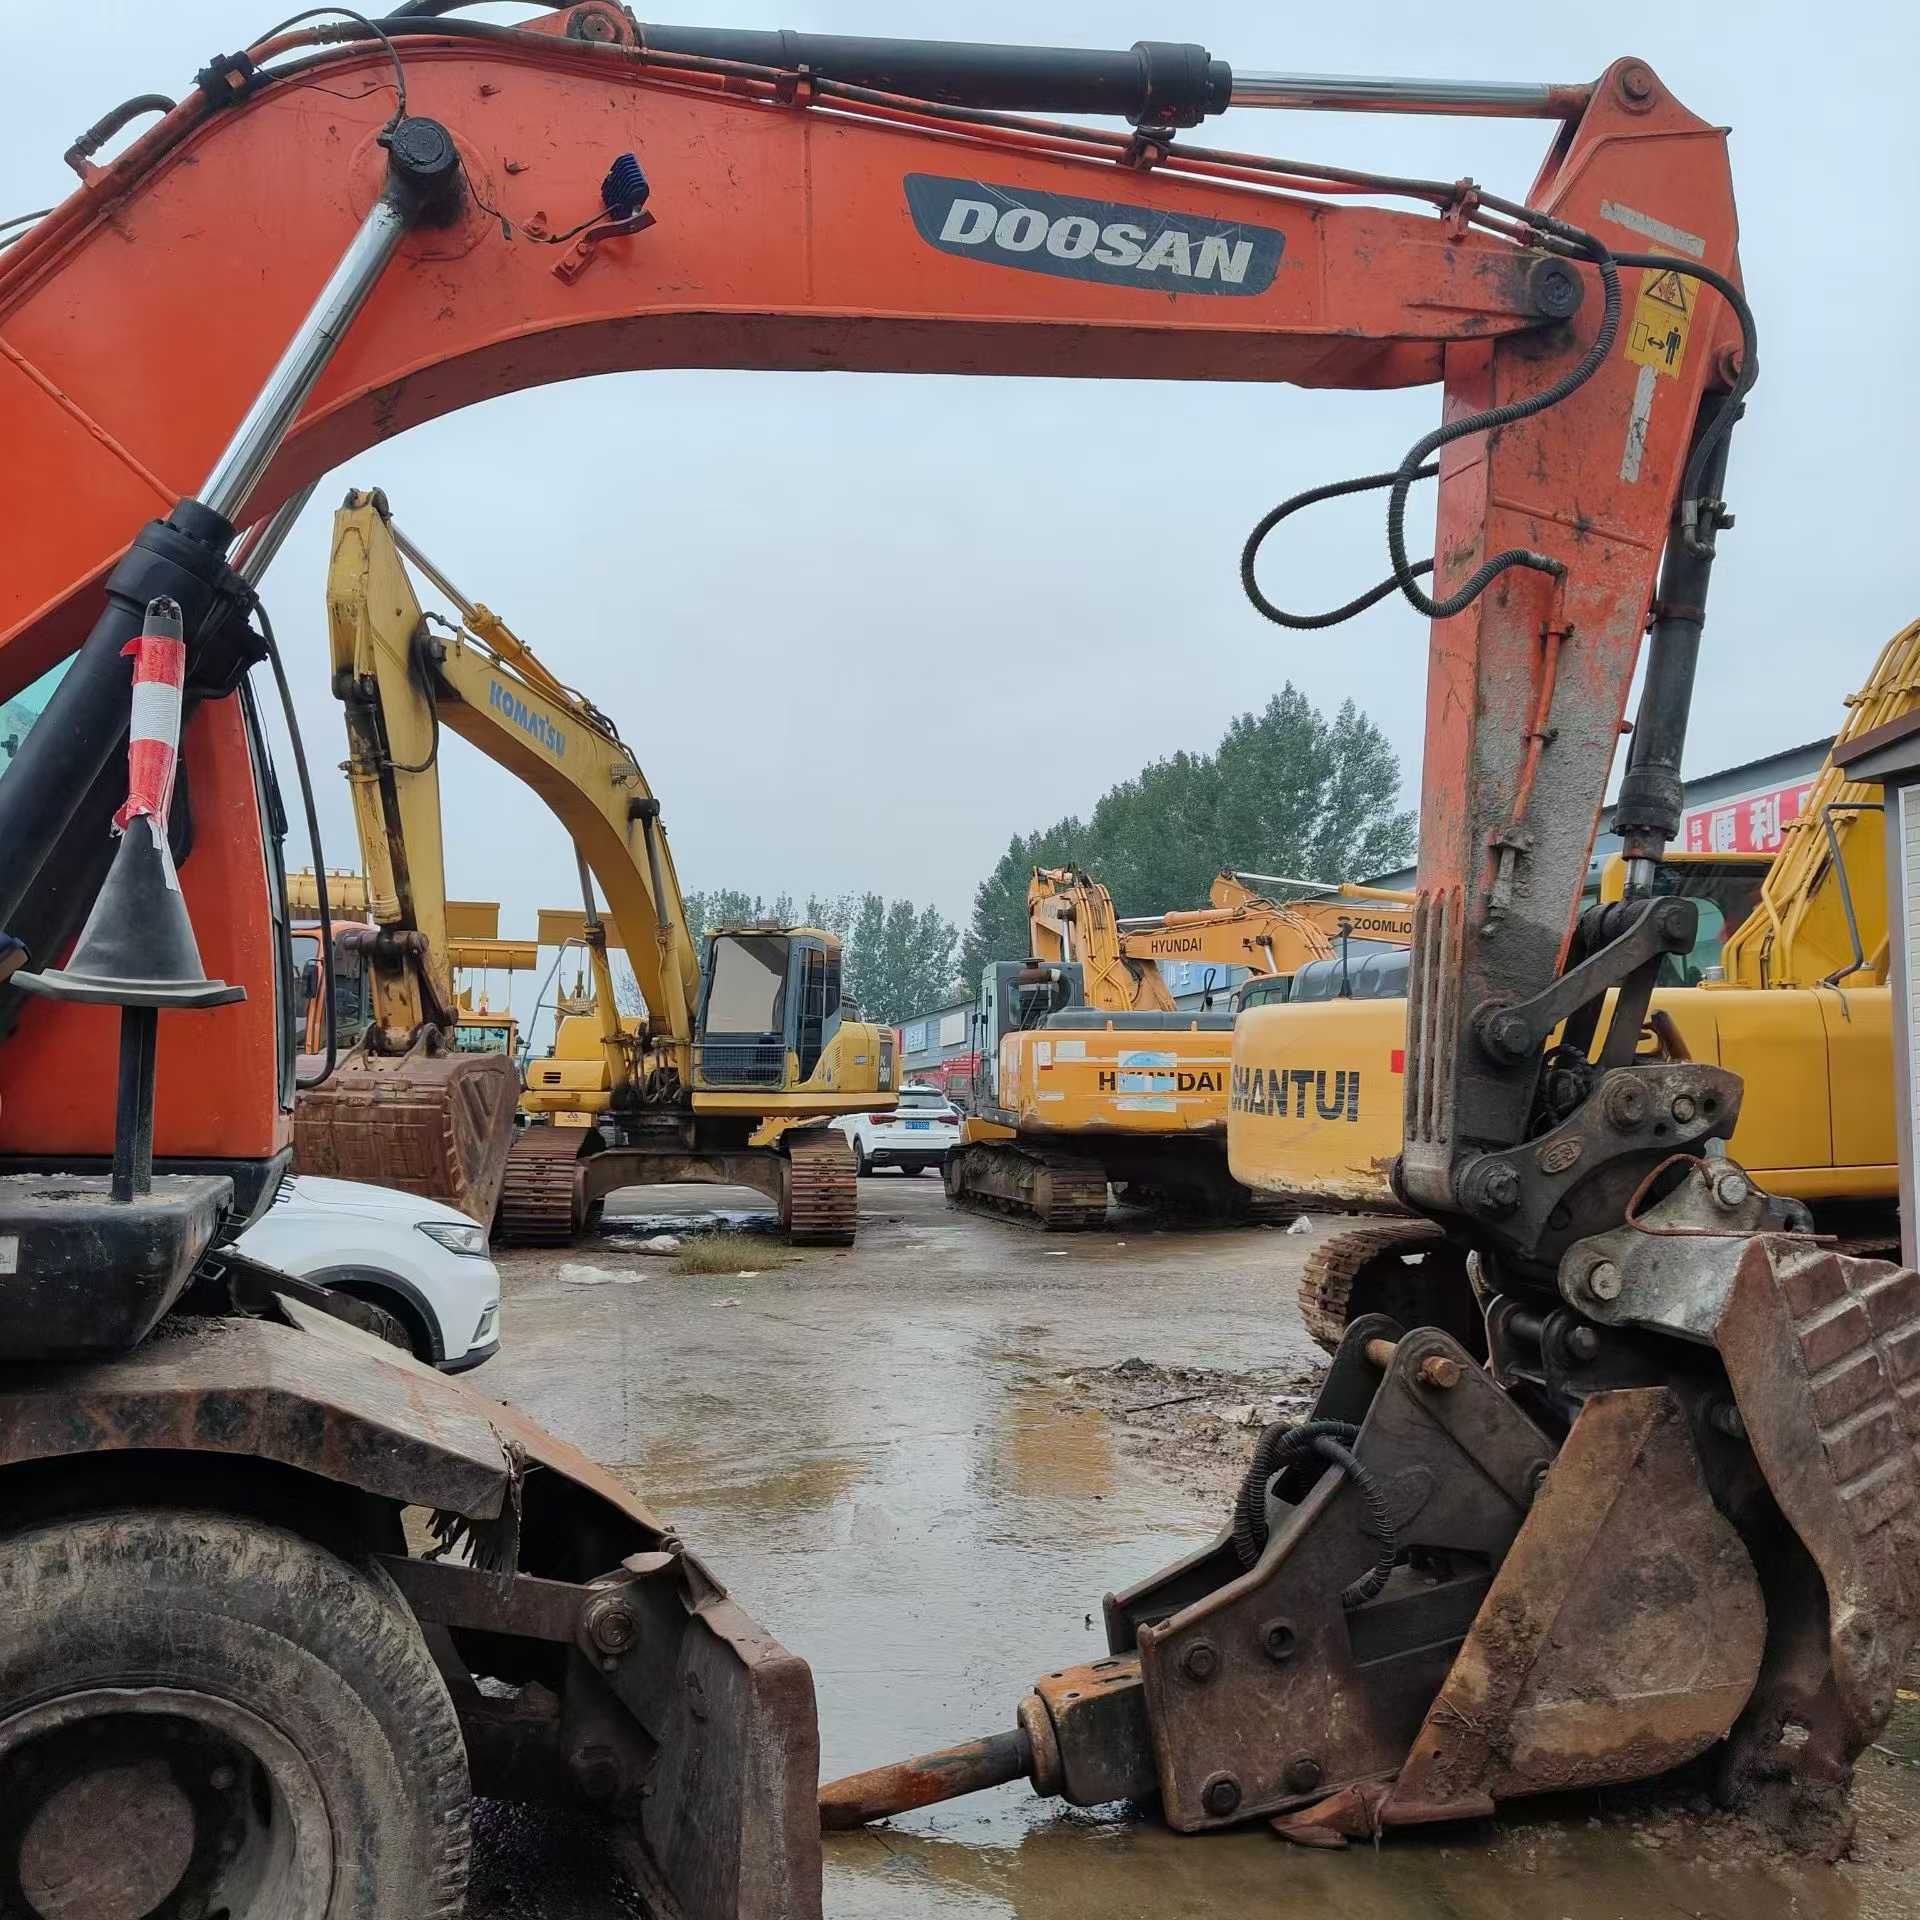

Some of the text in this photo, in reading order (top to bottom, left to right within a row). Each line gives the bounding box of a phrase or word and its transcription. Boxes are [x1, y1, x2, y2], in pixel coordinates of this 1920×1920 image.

[939, 199, 1254, 284] DOOSAN
[489, 679, 566, 758] KOMATSU
[1151, 937, 1202, 953] HYUNDAI
[1098, 1071, 1222, 1092] HDAI
